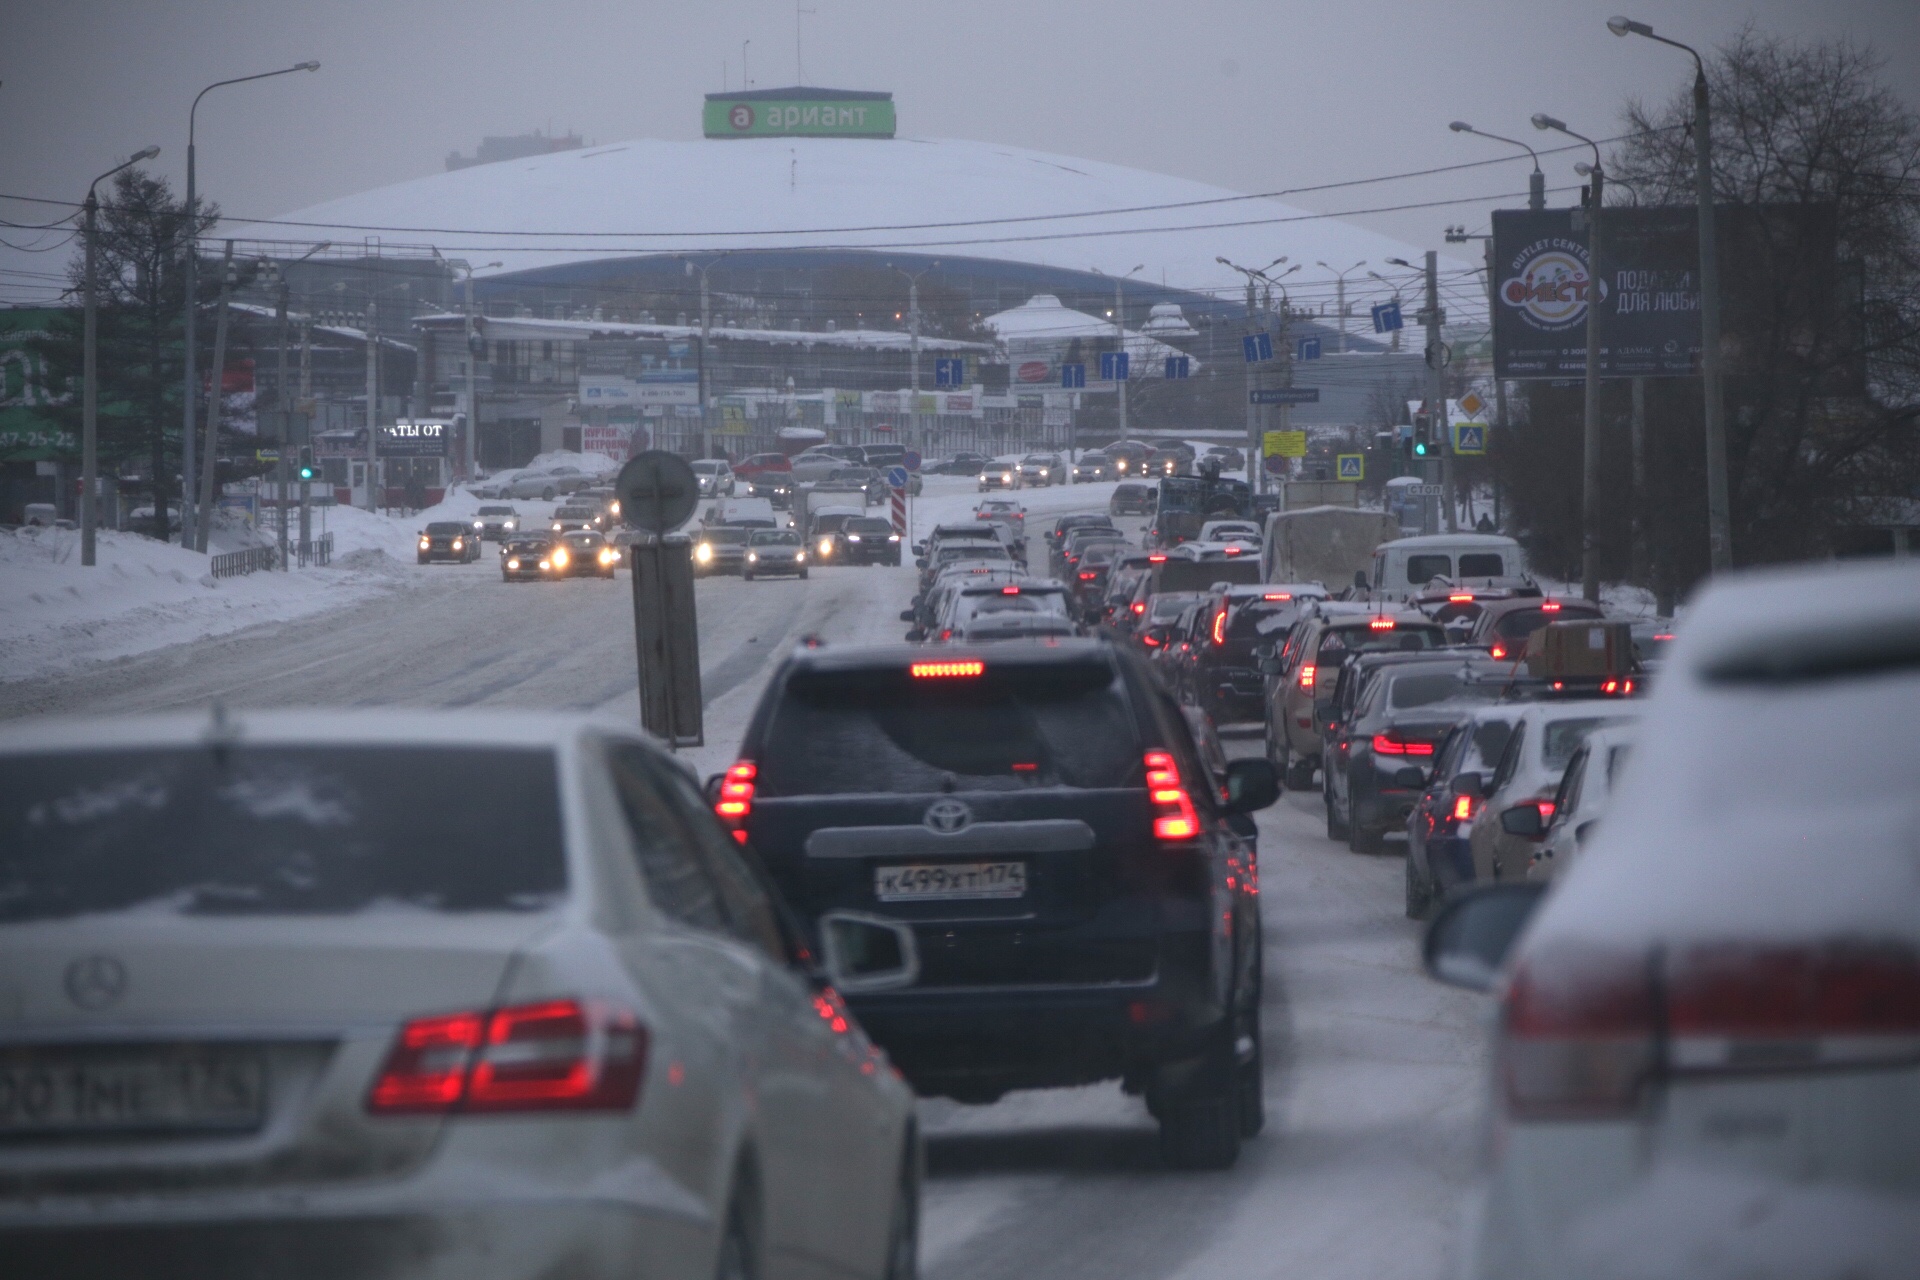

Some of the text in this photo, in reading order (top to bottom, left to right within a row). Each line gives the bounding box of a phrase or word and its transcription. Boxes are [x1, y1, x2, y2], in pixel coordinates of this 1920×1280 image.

[767, 105, 868, 131] ариант
[1512, 239, 1550, 270] OUTLET
[1616, 290, 1702, 314] ДЛЯ ЛЮБИ
[1262, 392, 1316, 400] ЕКАТЕРИНБУРГ
[423, 424, 443, 437] ОТ
[584, 428, 617, 438] КУРТКИ
[1410, 485, 1440, 494] СТОП
